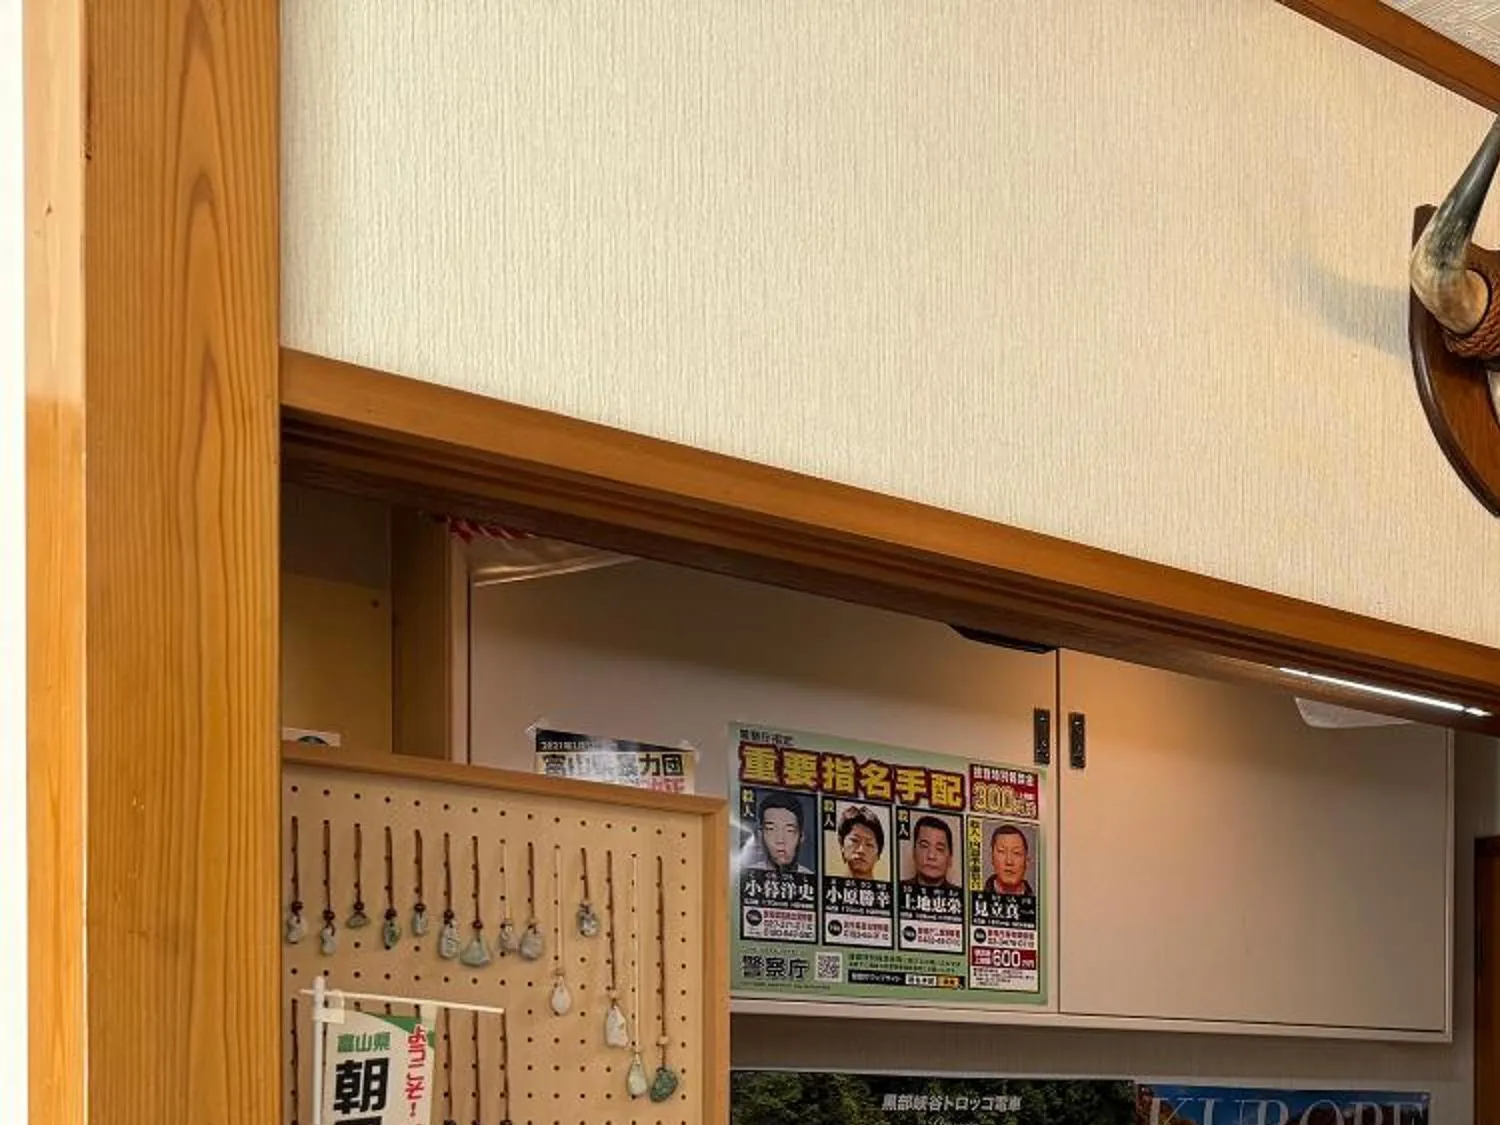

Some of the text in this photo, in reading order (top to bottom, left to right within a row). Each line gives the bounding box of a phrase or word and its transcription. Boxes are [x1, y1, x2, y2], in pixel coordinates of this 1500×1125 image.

[739, 742, 964, 811] 重要指名手配
[337, 1032, 391, 1053] 富山県
